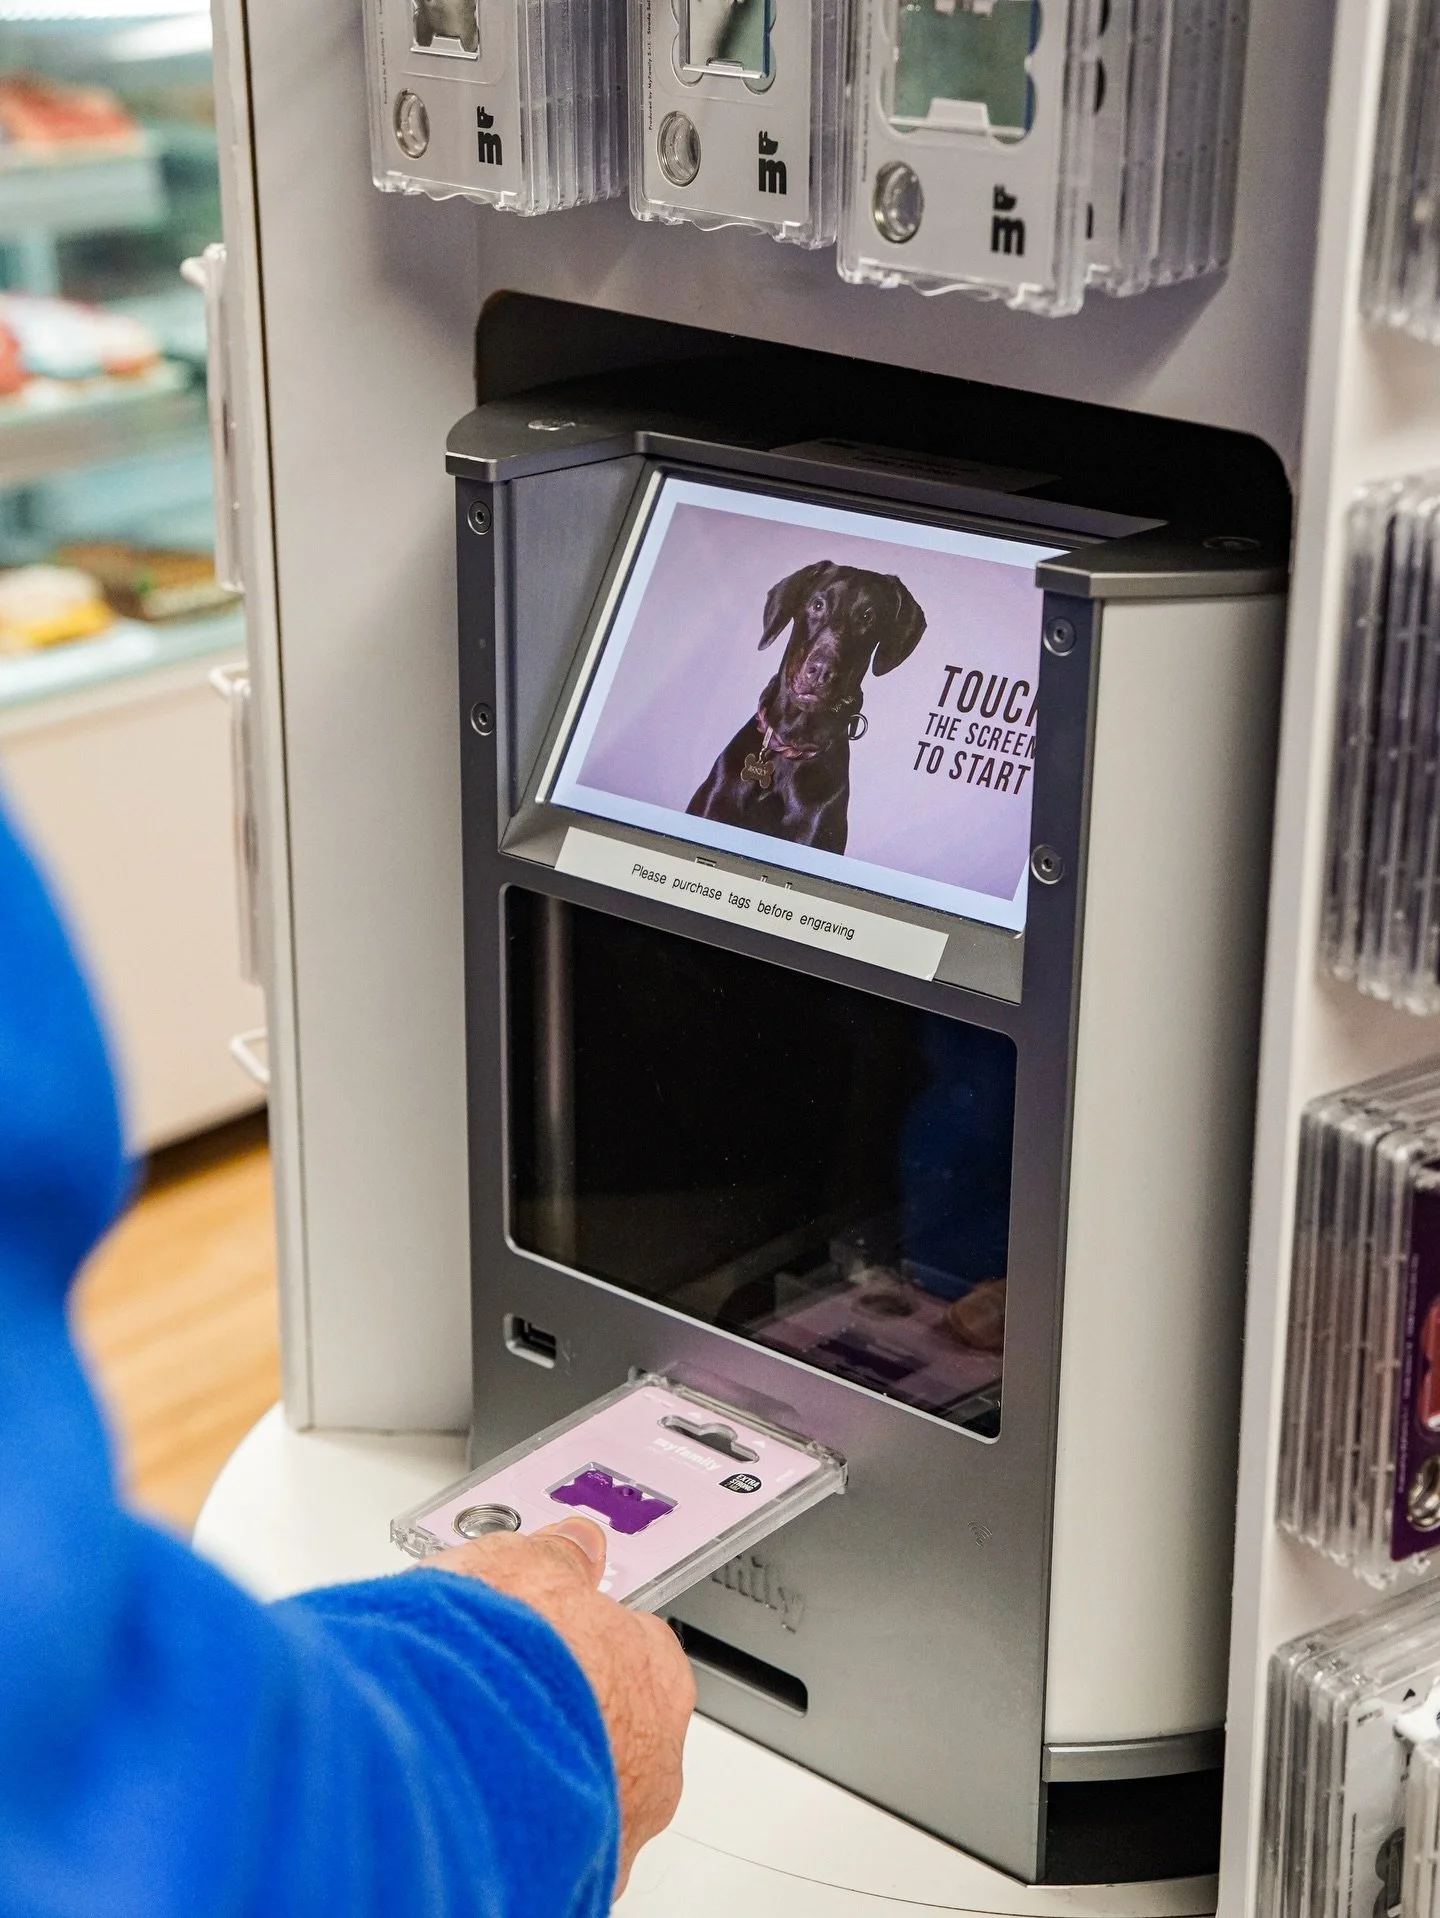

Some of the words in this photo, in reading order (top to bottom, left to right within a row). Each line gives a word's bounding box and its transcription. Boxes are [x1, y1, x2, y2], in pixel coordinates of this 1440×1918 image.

[925, 712, 962, 741] THE
[913, 740, 945, 774] TO
[948, 750, 1032, 795] START
[631, 863, 667, 885] Please
[672, 877, 722, 901] purchase
[728, 891, 751, 909] tags
[757, 899, 793, 921] before
[799, 914, 855, 941] engraving
[653, 1438, 722, 1471] myfamily
[729, 1478, 754, 1492] STRONG
[735, 1474, 761, 1488] EXTRA
